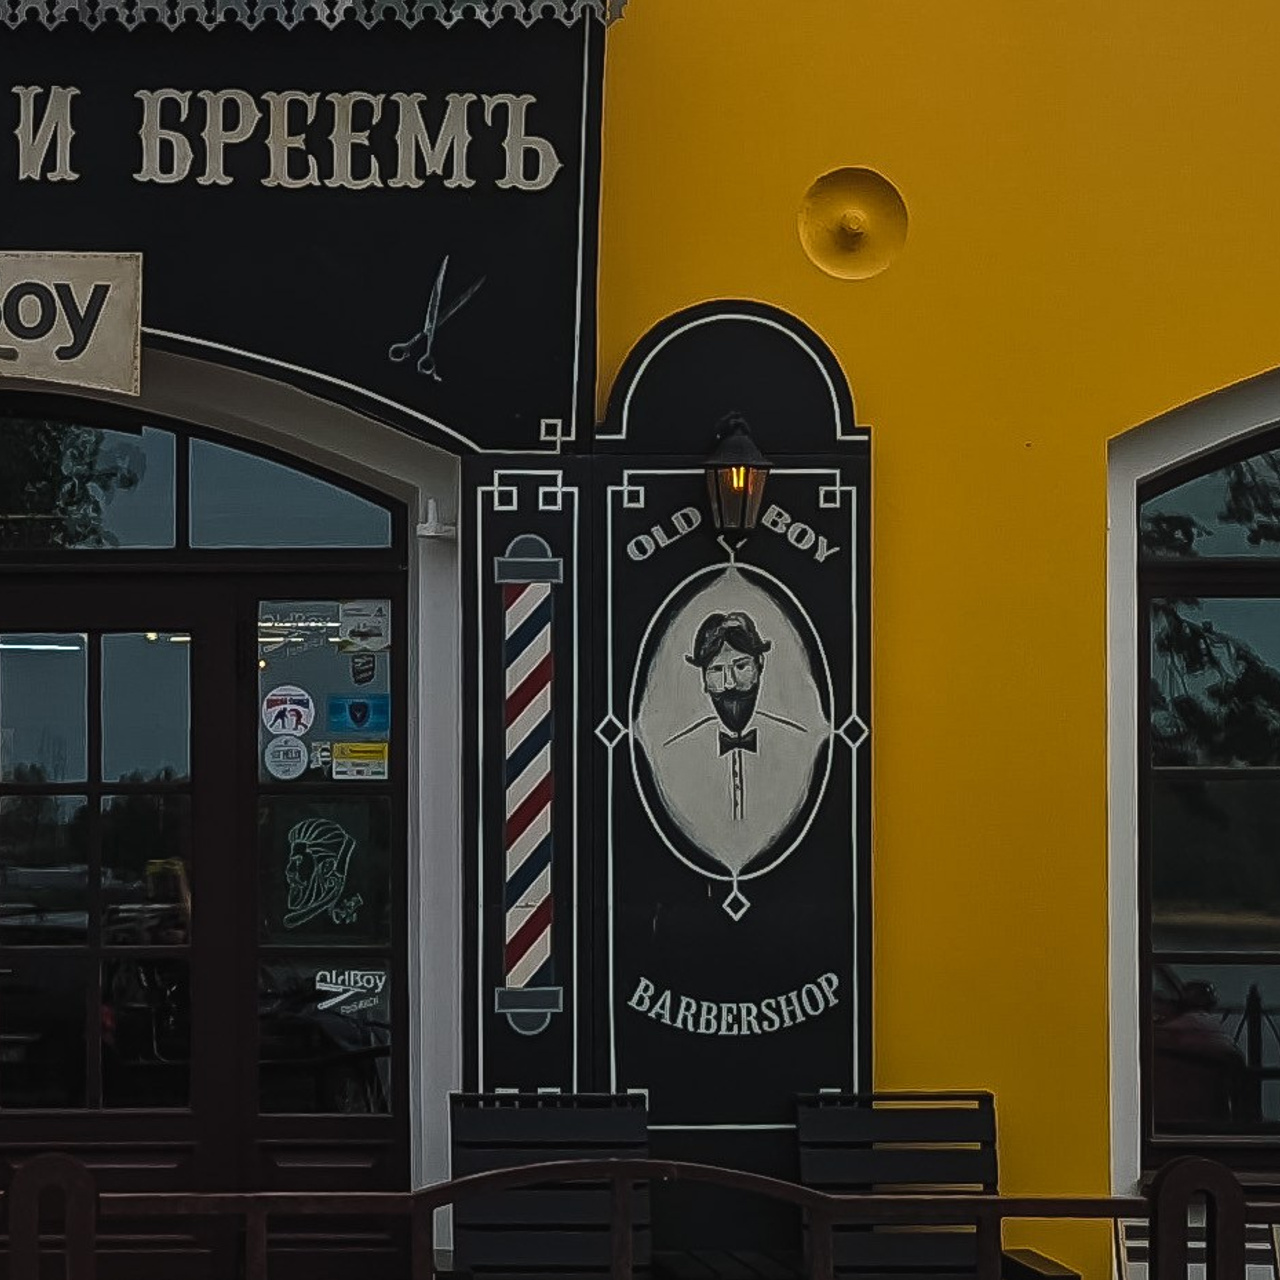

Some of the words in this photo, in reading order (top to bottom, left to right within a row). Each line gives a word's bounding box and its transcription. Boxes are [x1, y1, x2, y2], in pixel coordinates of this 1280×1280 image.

[11, 85, 81, 181] И
[132, 88, 564, 190] БРЕЕМЪ
[626, 506, 703, 562] OLD
[761, 504, 841, 564] BOY
[316, 970, 387, 994] OldBoy
[627, 972, 841, 1035] BARBERSHOP
